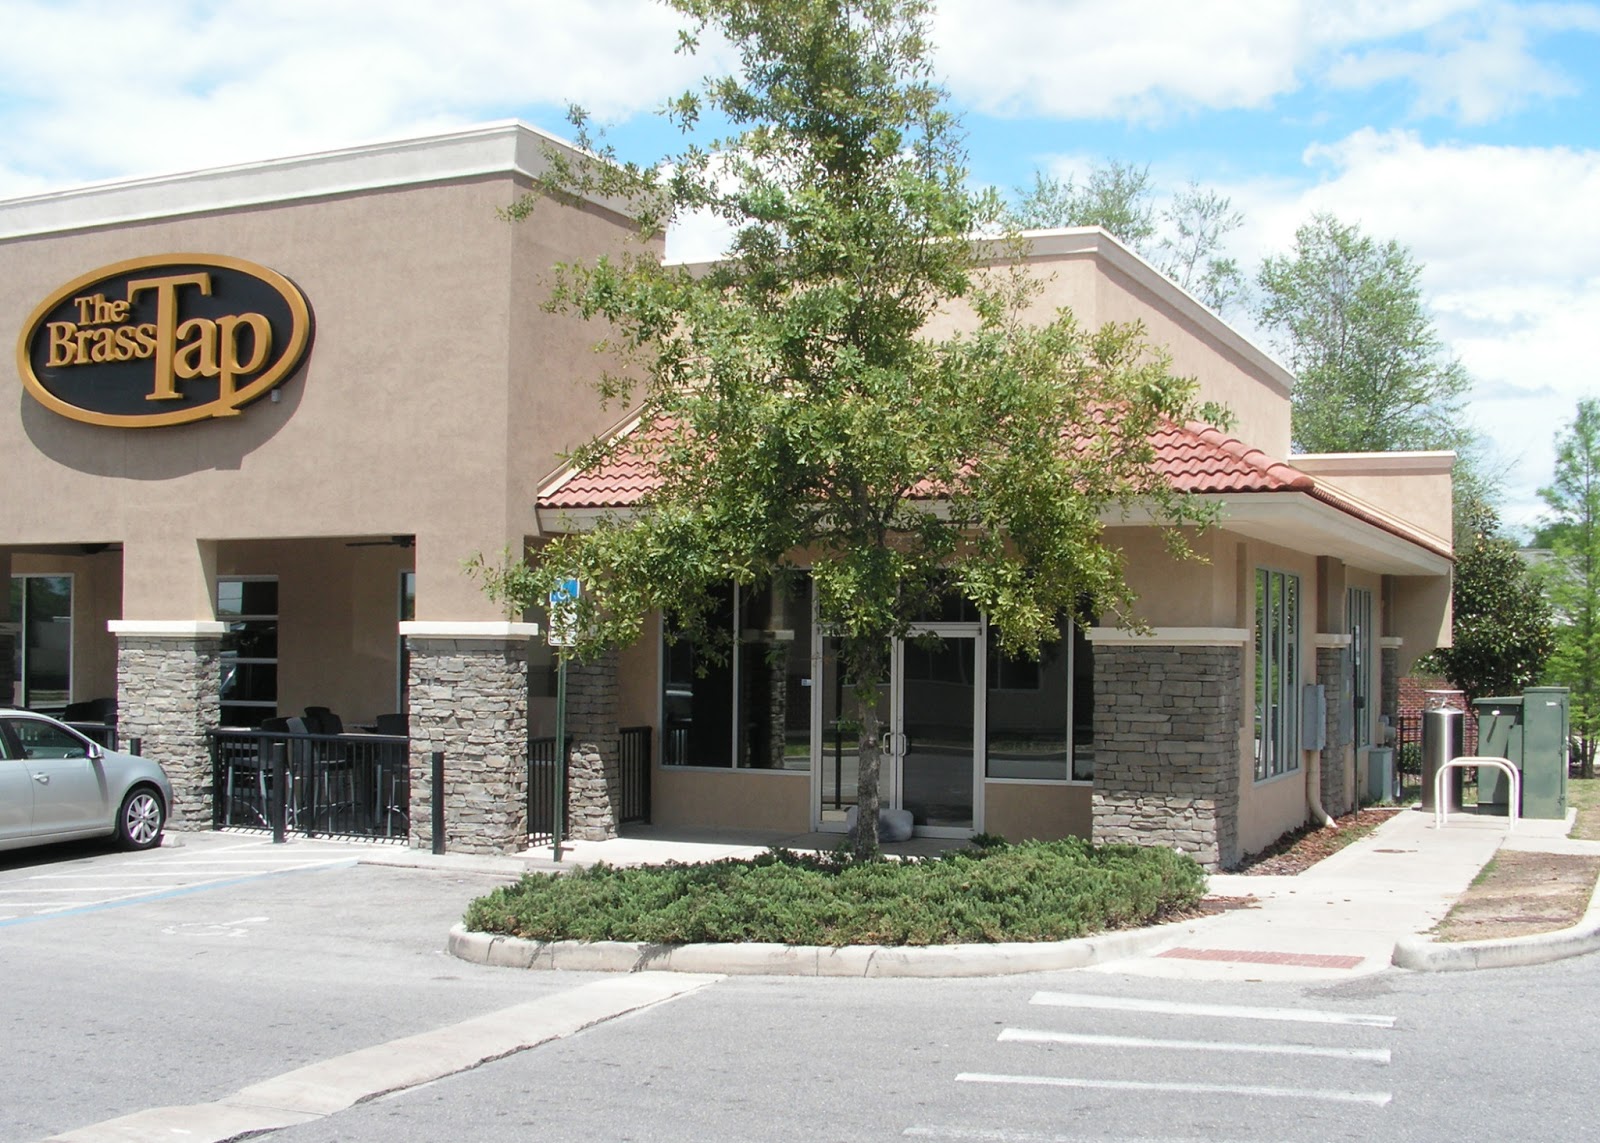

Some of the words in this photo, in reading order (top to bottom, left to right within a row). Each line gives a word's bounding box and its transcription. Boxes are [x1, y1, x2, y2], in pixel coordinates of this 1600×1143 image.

[45, 321, 158, 367] Brass
[127, 272, 273, 417] Tap
[74, 293, 130, 326] The
